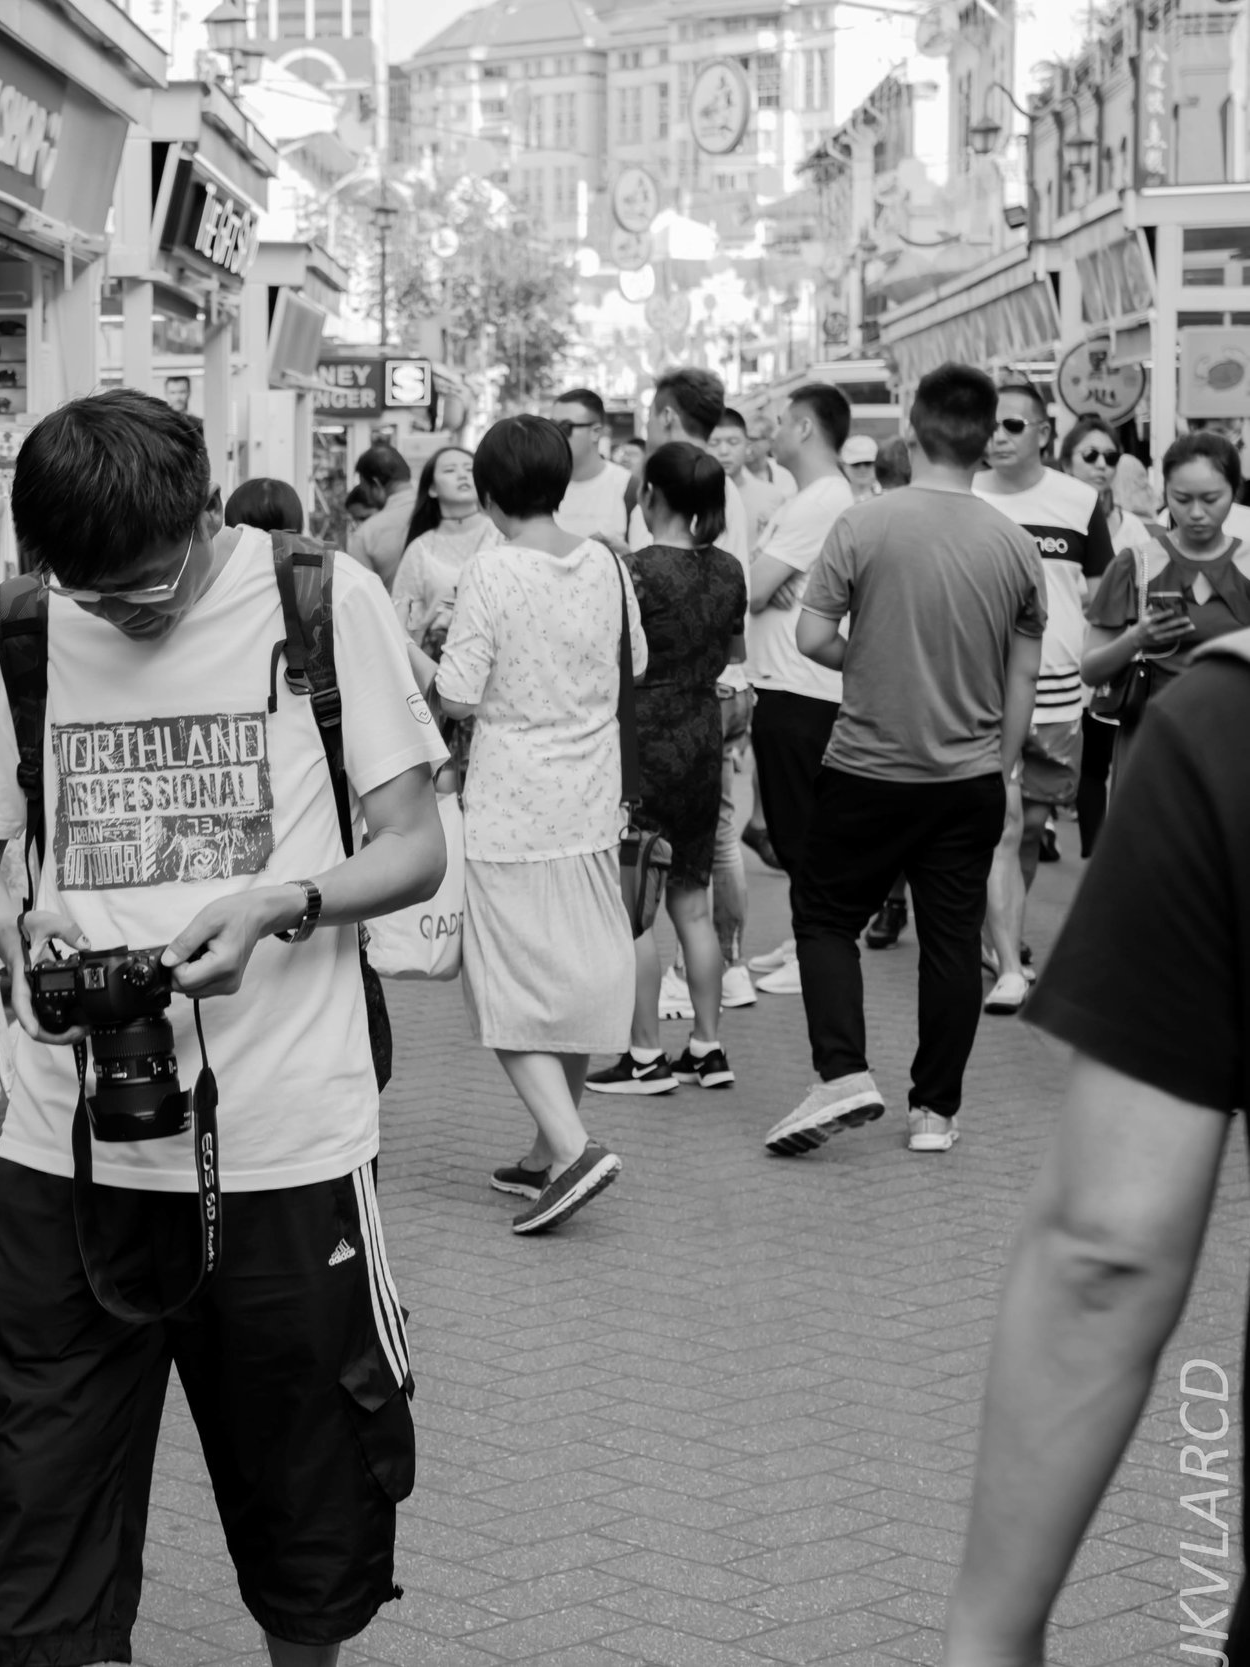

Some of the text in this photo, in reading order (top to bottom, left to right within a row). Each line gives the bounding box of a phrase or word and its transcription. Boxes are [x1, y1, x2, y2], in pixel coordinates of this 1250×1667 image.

[68, 770, 255, 817] PROFESSIONAL
[69, 823, 104, 845] URBAN
[64, 845, 140, 886] OUTDOOR
[201, 1132, 215, 1188] EOS
[205, 1192, 216, 1221] 6D
